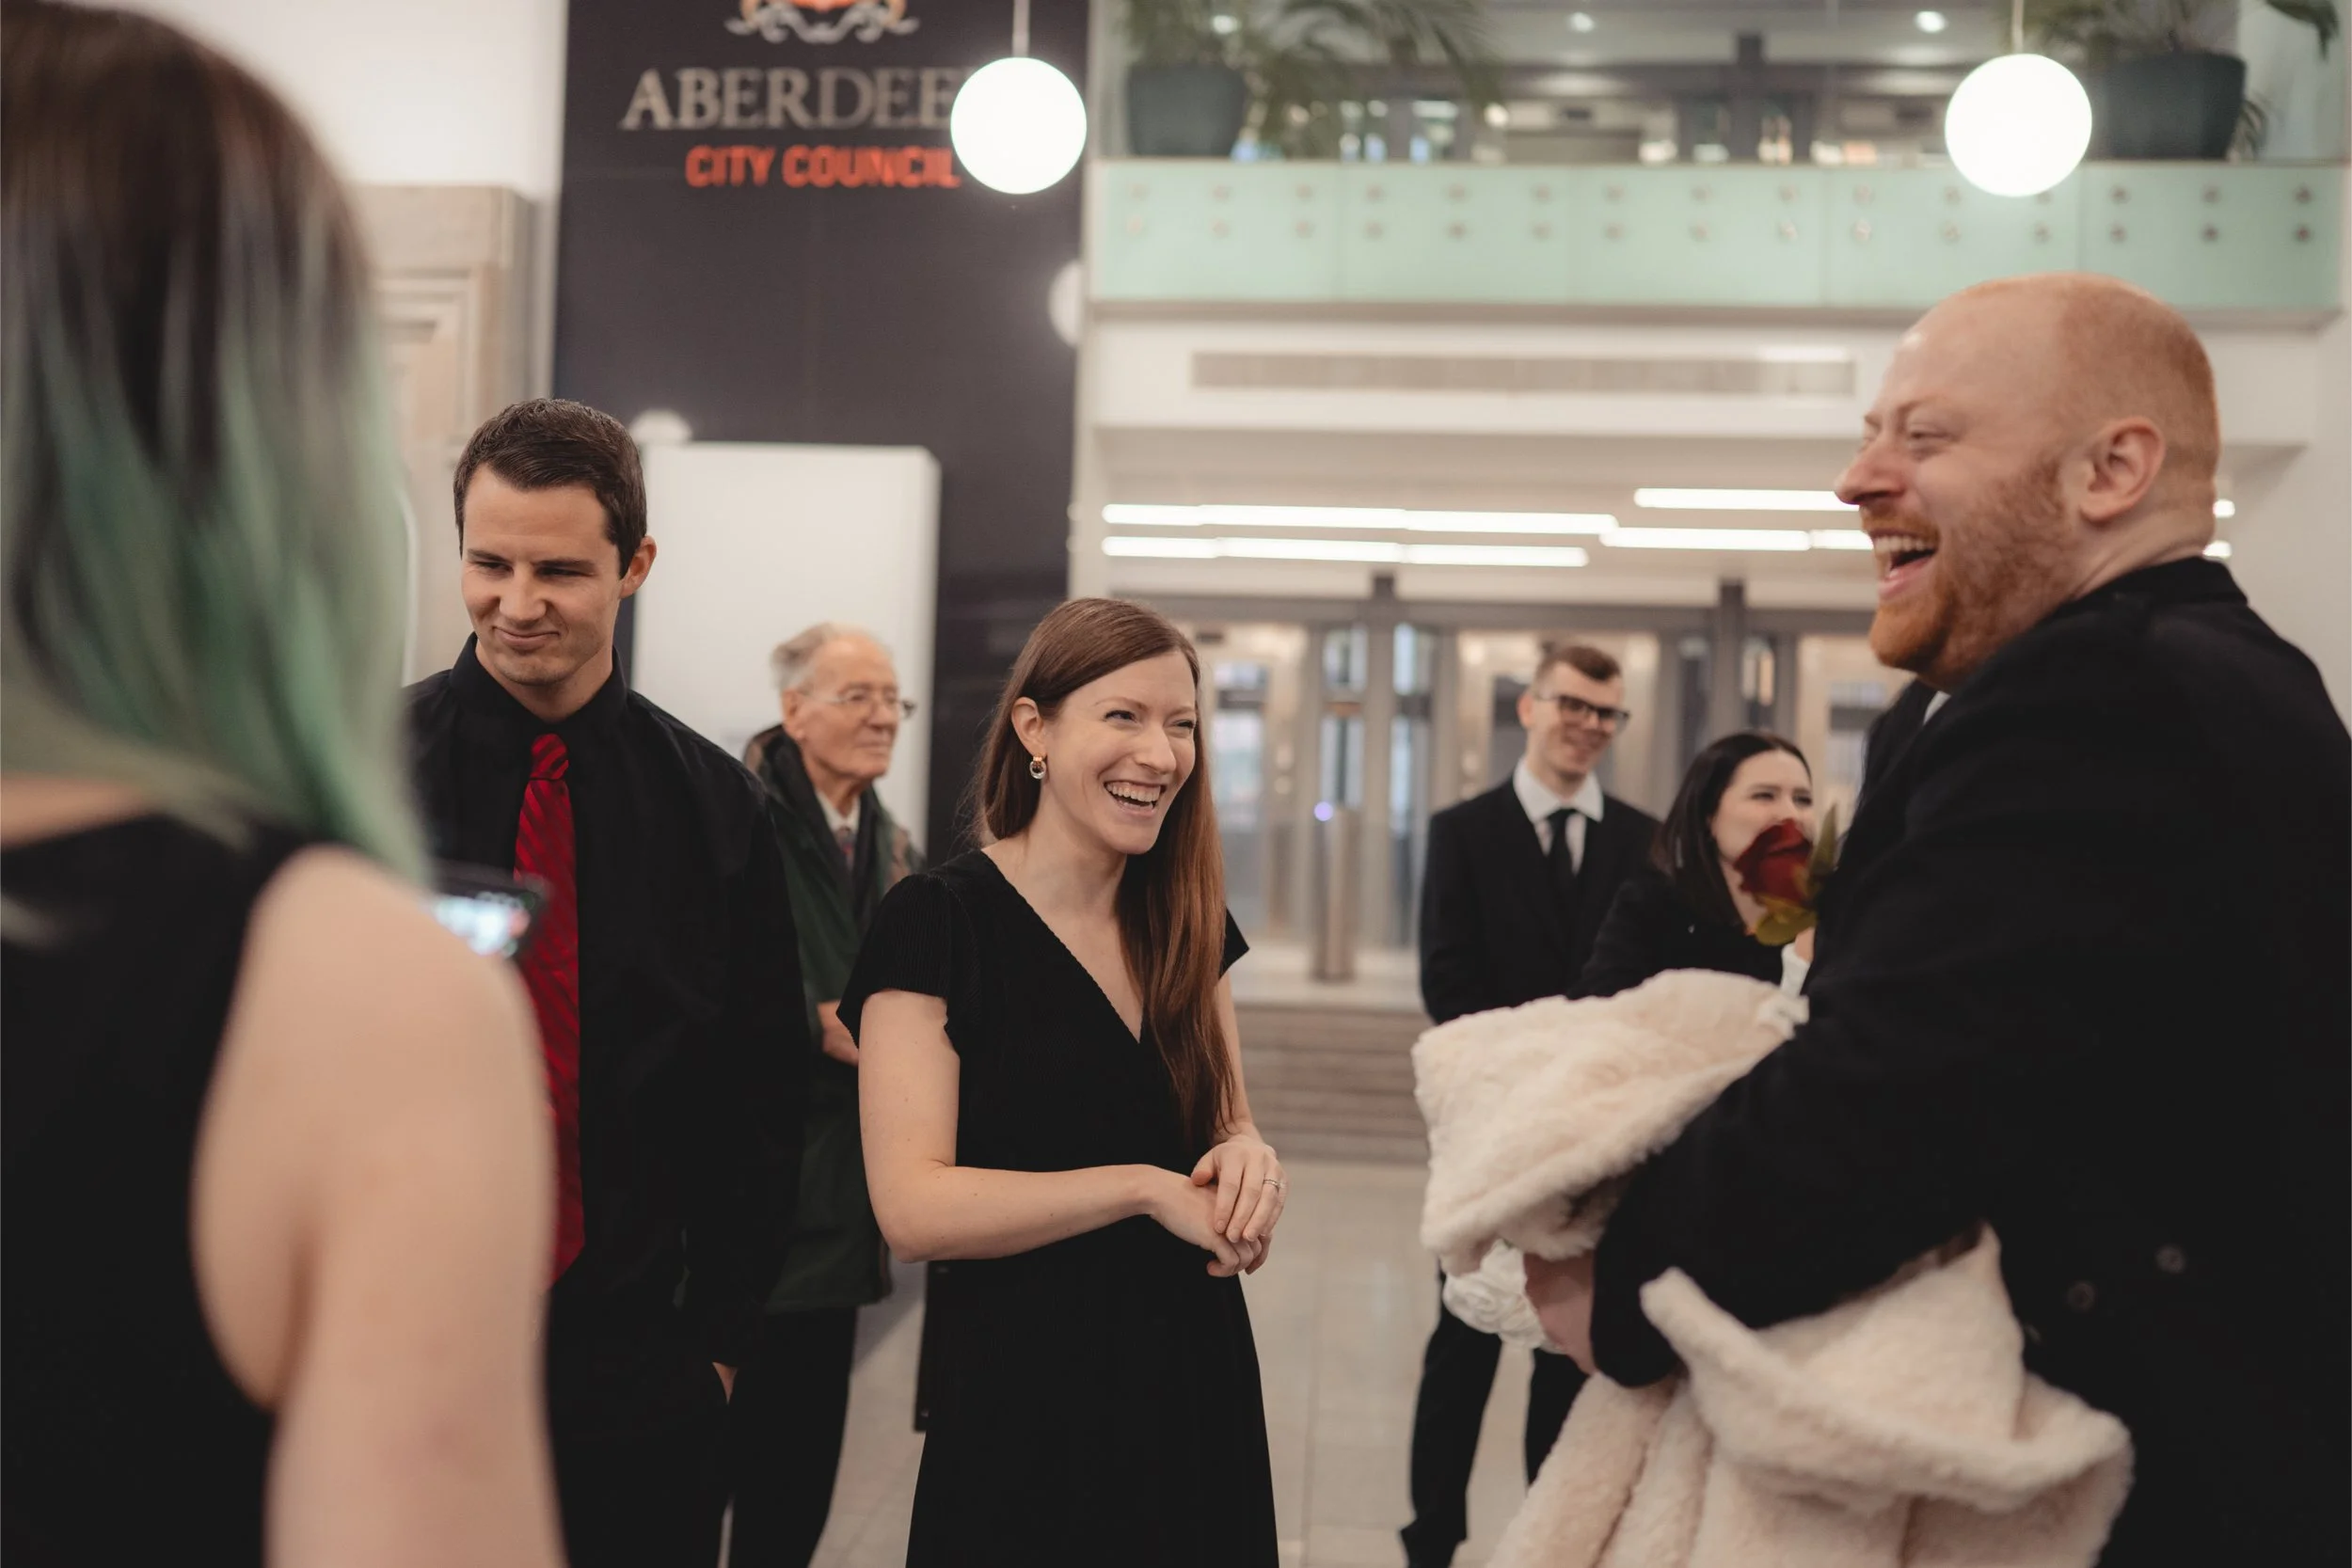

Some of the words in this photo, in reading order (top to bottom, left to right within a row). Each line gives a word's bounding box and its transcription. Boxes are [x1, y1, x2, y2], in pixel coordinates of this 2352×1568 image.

[620, 68, 977, 130] ABERDEE
[685, 145, 776, 187] CITY
[782, 145, 961, 187] COUNCIL
